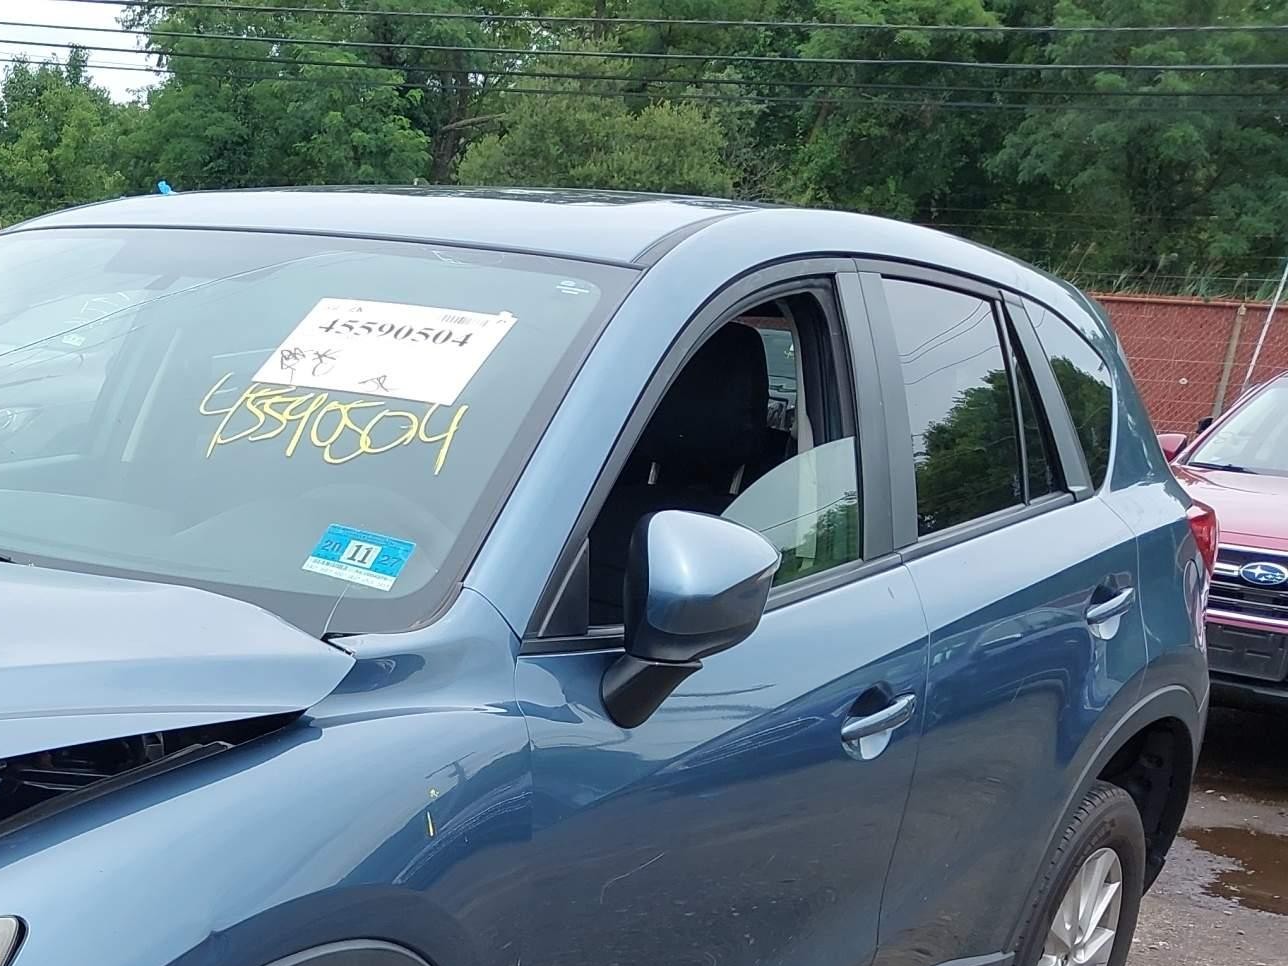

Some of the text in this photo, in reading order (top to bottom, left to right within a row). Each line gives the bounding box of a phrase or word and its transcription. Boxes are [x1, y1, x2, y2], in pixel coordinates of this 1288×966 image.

[318, 318, 474, 348] 45590504
[199, 371, 469, 475] 45590504
[346, 543, 374, 565] 11
[377, 554, 401, 569] 27
